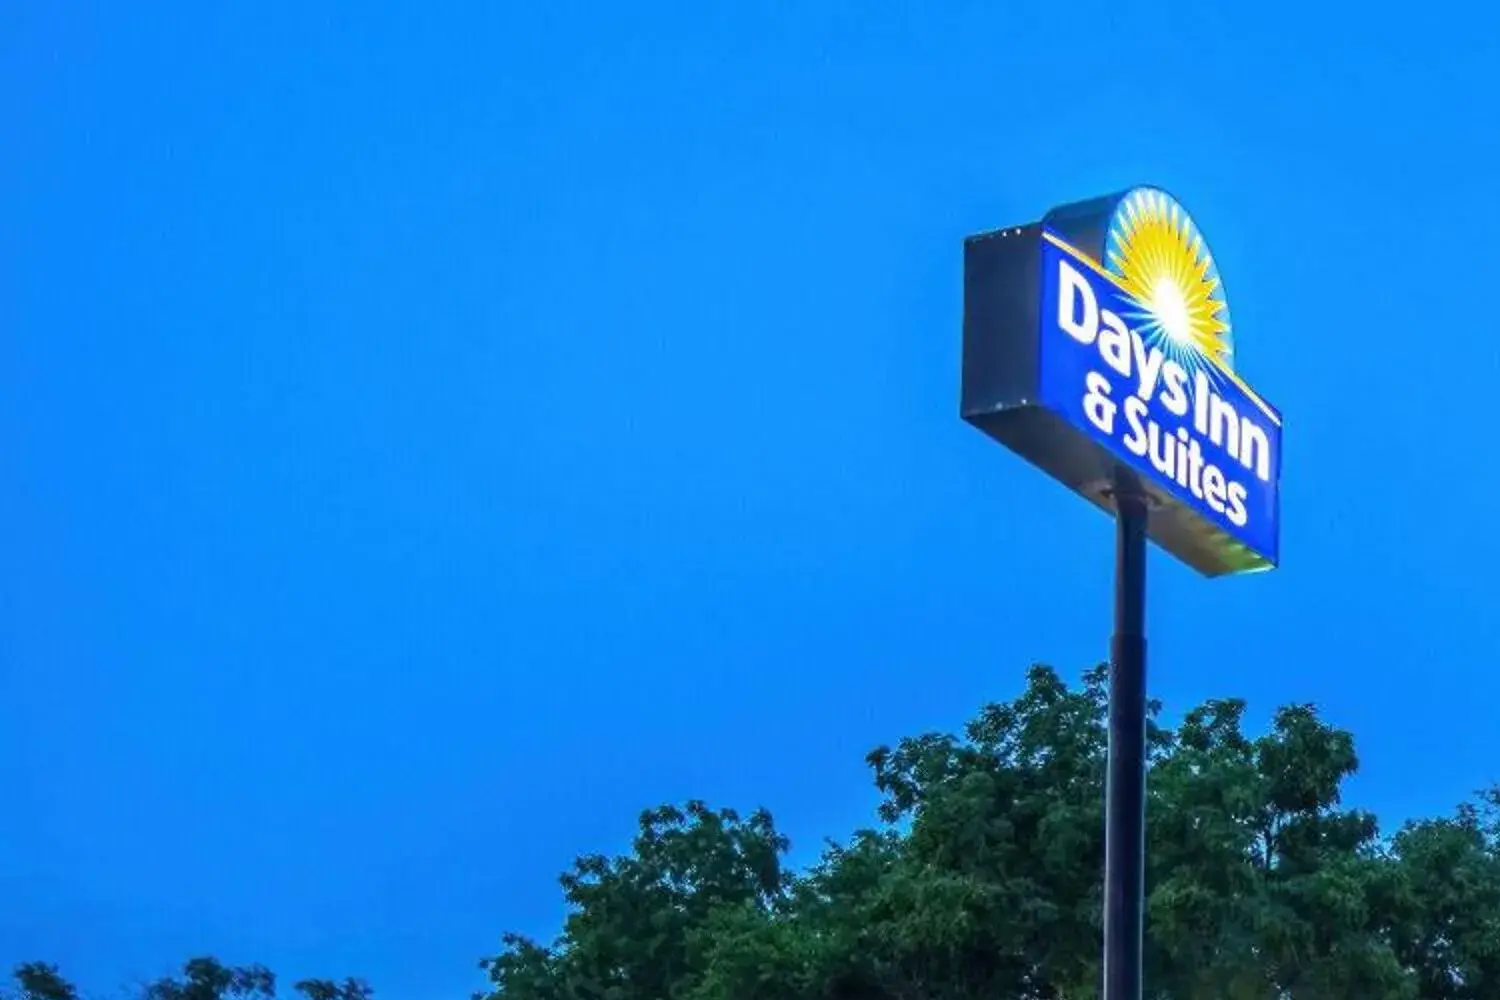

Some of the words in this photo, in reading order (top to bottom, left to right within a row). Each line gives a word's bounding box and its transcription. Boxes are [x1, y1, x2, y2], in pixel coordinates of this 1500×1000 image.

[1057, 259, 1188, 416] Days
[1193, 368, 1269, 482] Inn
[1083, 371, 1117, 435] &
[1123, 395, 1248, 527] Suites
